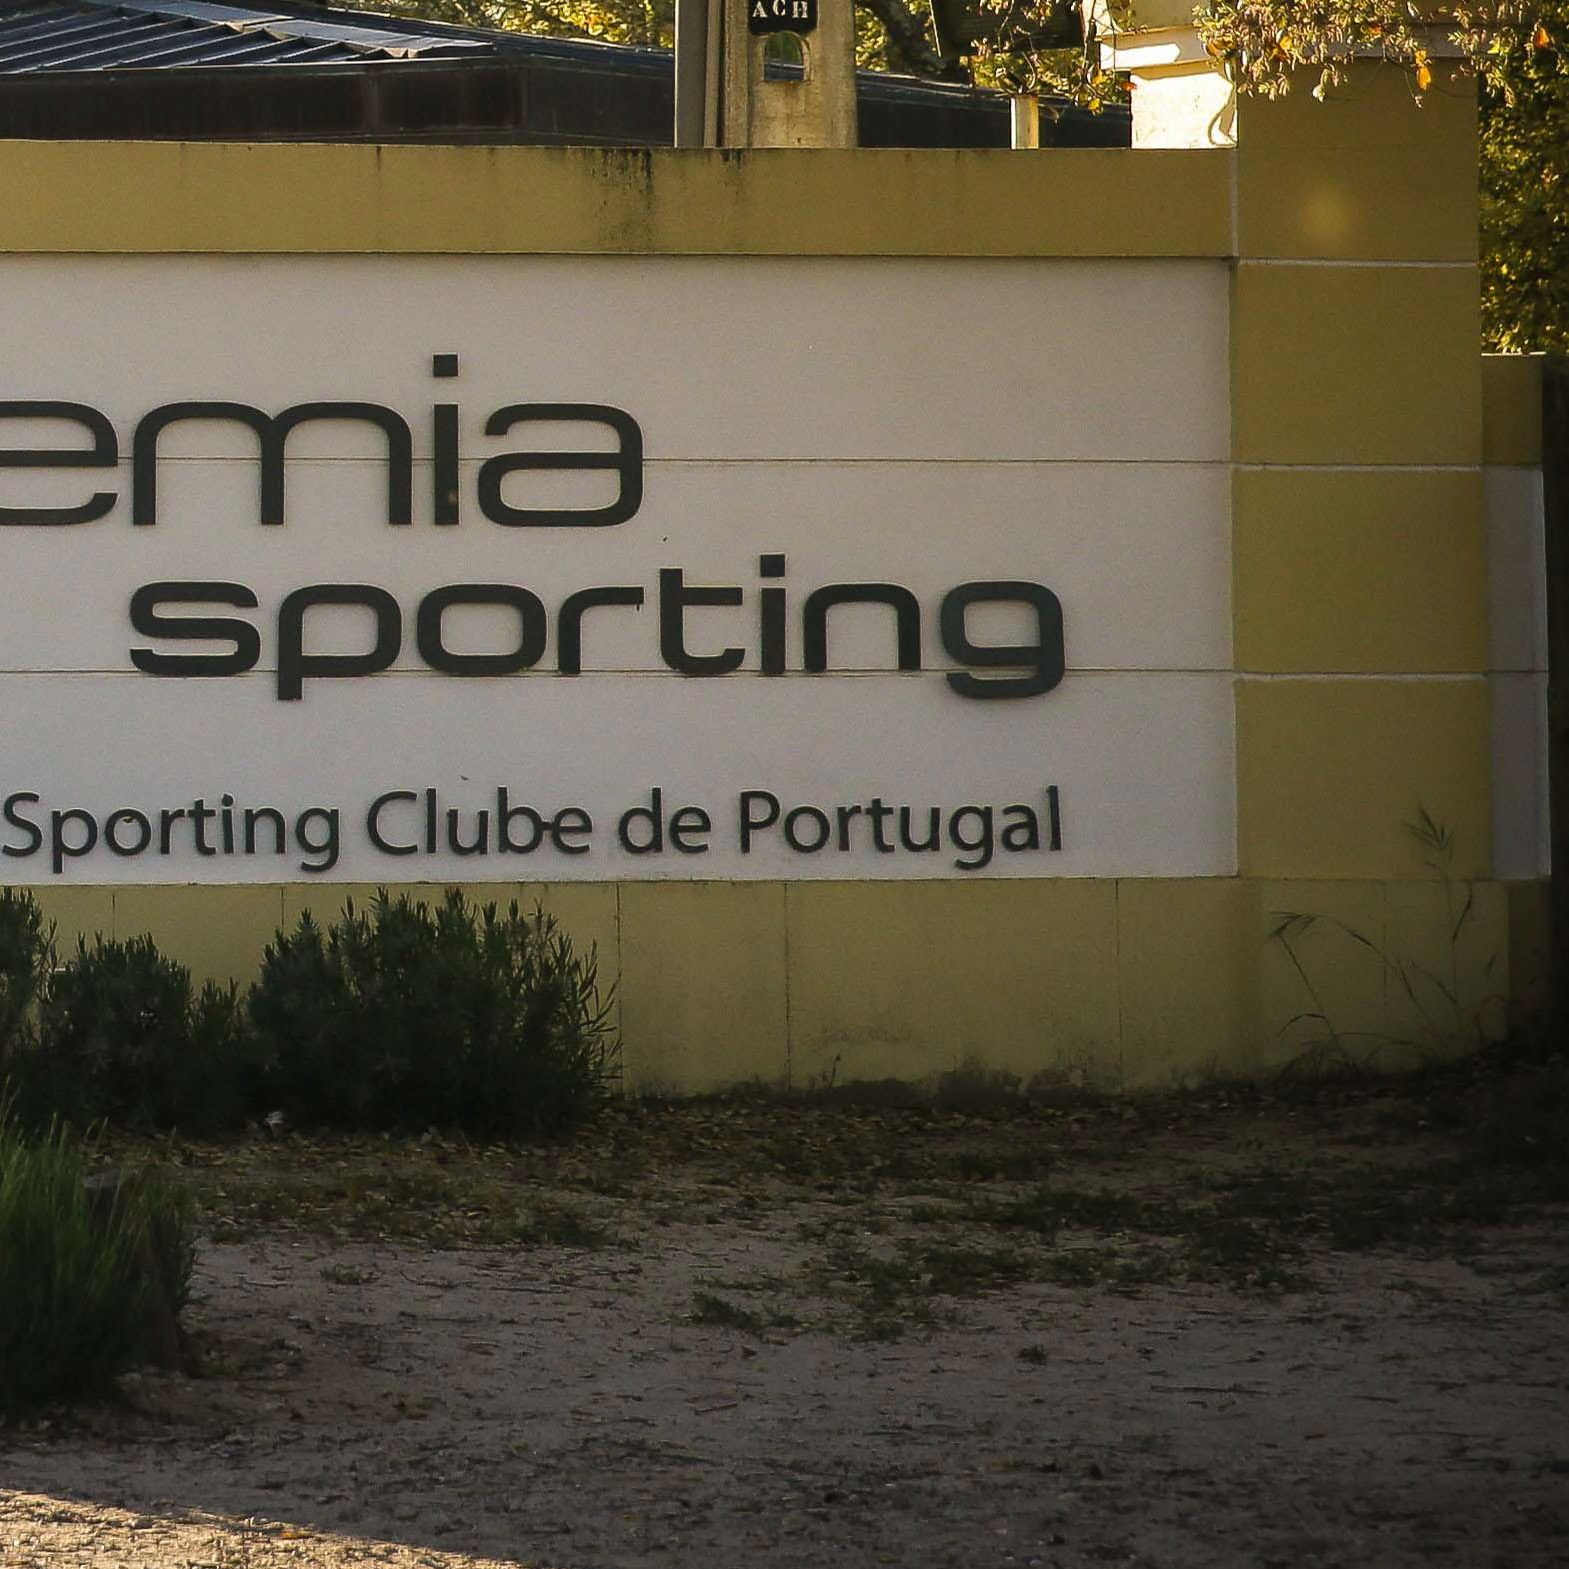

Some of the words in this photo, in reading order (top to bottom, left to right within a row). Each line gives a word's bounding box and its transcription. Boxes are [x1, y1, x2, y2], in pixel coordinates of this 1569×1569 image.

[129, 554, 1064, 700] sporting
[2, 792, 340, 874] Sporting
[366, 787, 593, 858] Clube
[618, 786, 712, 857] de
[738, 784, 1062, 874] Portugal
